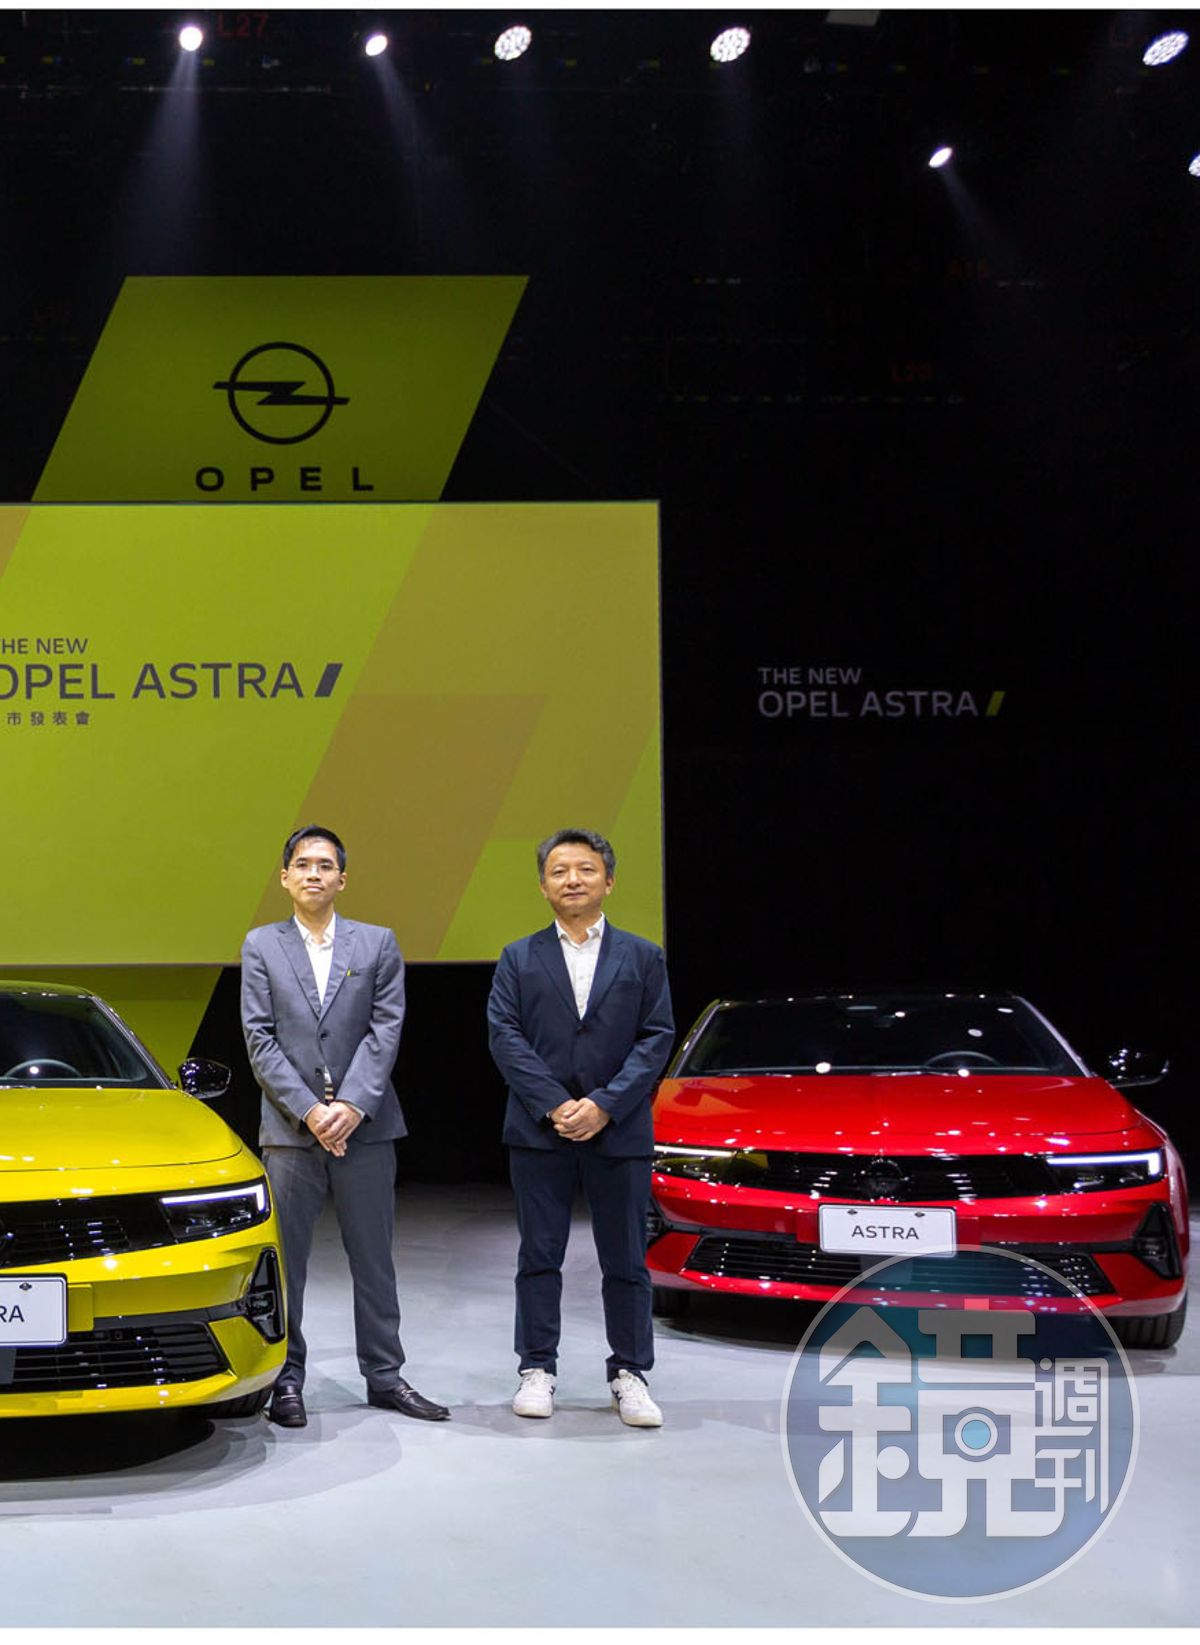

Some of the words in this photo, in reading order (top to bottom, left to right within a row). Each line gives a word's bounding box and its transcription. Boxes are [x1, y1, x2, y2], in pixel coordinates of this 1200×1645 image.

[216, 10, 269, 39] L27
[195, 466, 375, 492] OPEL
[36, 638, 88, 654] NEW
[131, 662, 304, 699] ASTRA
[757, 667, 801, 685] THE
[808, 667, 863, 685] NEW
[757, 690, 850, 718] OPEL
[858, 690, 980, 718] ASTRA
[851, 1224, 920, 1241] ASTRA
